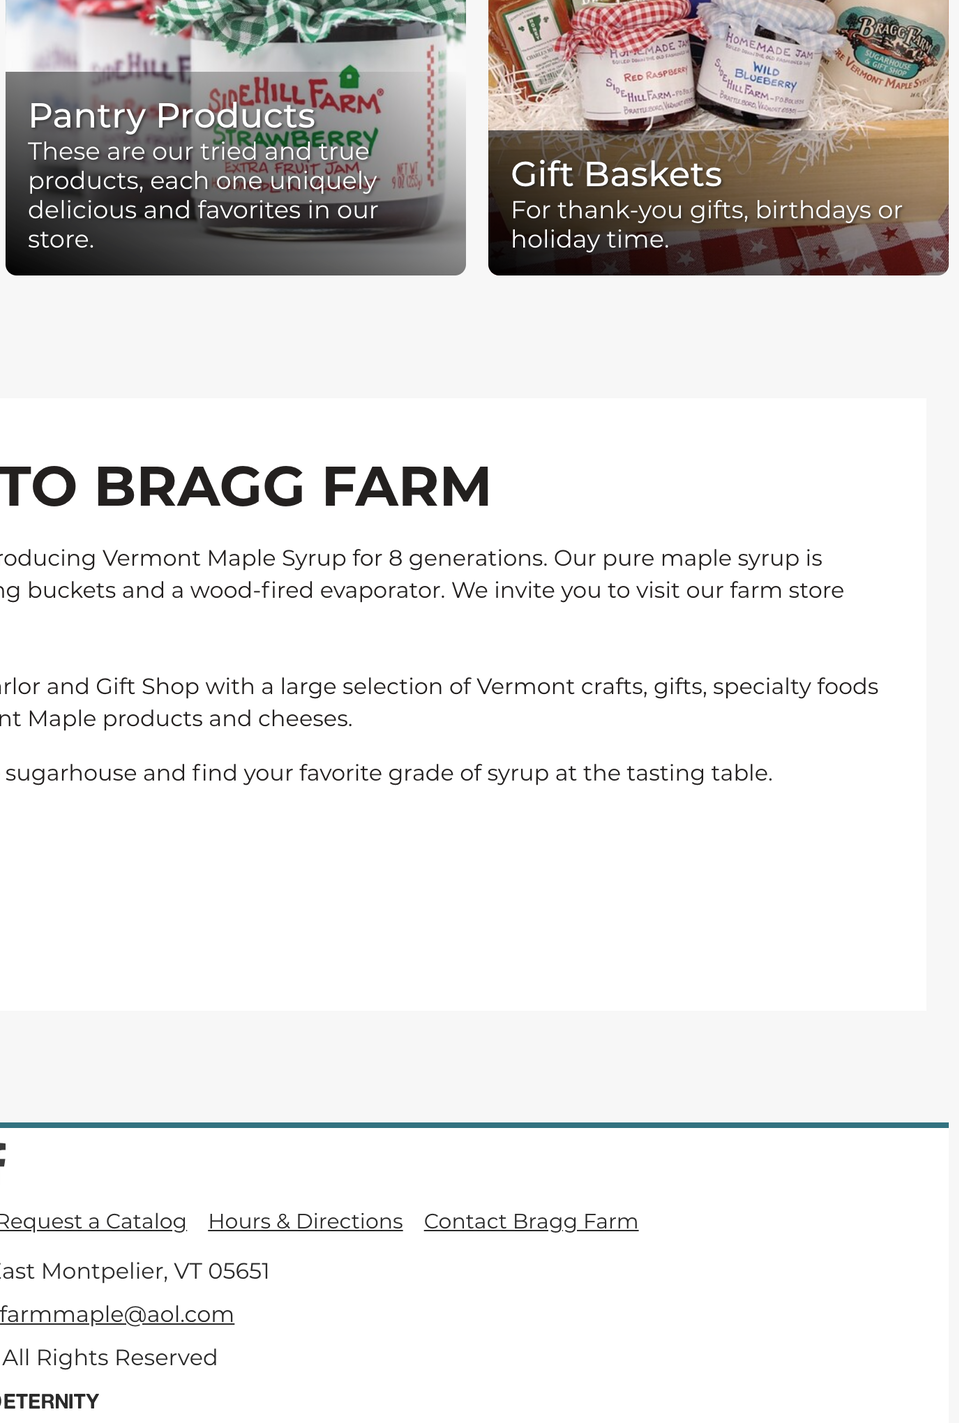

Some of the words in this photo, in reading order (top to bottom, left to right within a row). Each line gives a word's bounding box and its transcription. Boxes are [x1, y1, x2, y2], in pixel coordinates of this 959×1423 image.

[726, 32, 791, 57] HOMEMADE
[795, 48, 814, 60] JAM
[858, 15, 906, 39] BRAGG
[903, 25, 934, 55] FARM
[753, 61, 780, 77] WILD
[864, 50, 911, 71] SUGARHOUSE
[872, 61, 887, 72] GIFT
[889, 66, 908, 77] SHOP
[624, 73, 643, 83] RED
[646, 66, 688, 80] RASPBERRY
[735, 68, 797, 93] BLUEBERRY
[845, 56, 884, 85] VERMONT
[884, 77, 913, 90] MAPLE
[97, 465, 303, 508] BRAGG
[325, 465, 489, 507] FARM
[42, 1261, 168, 1284] Montpelier,
[173, 1262, 203, 1280] VT
[208, 1262, 268, 1280] 05651
[3, 1393, 100, 1410] ETERNITY
